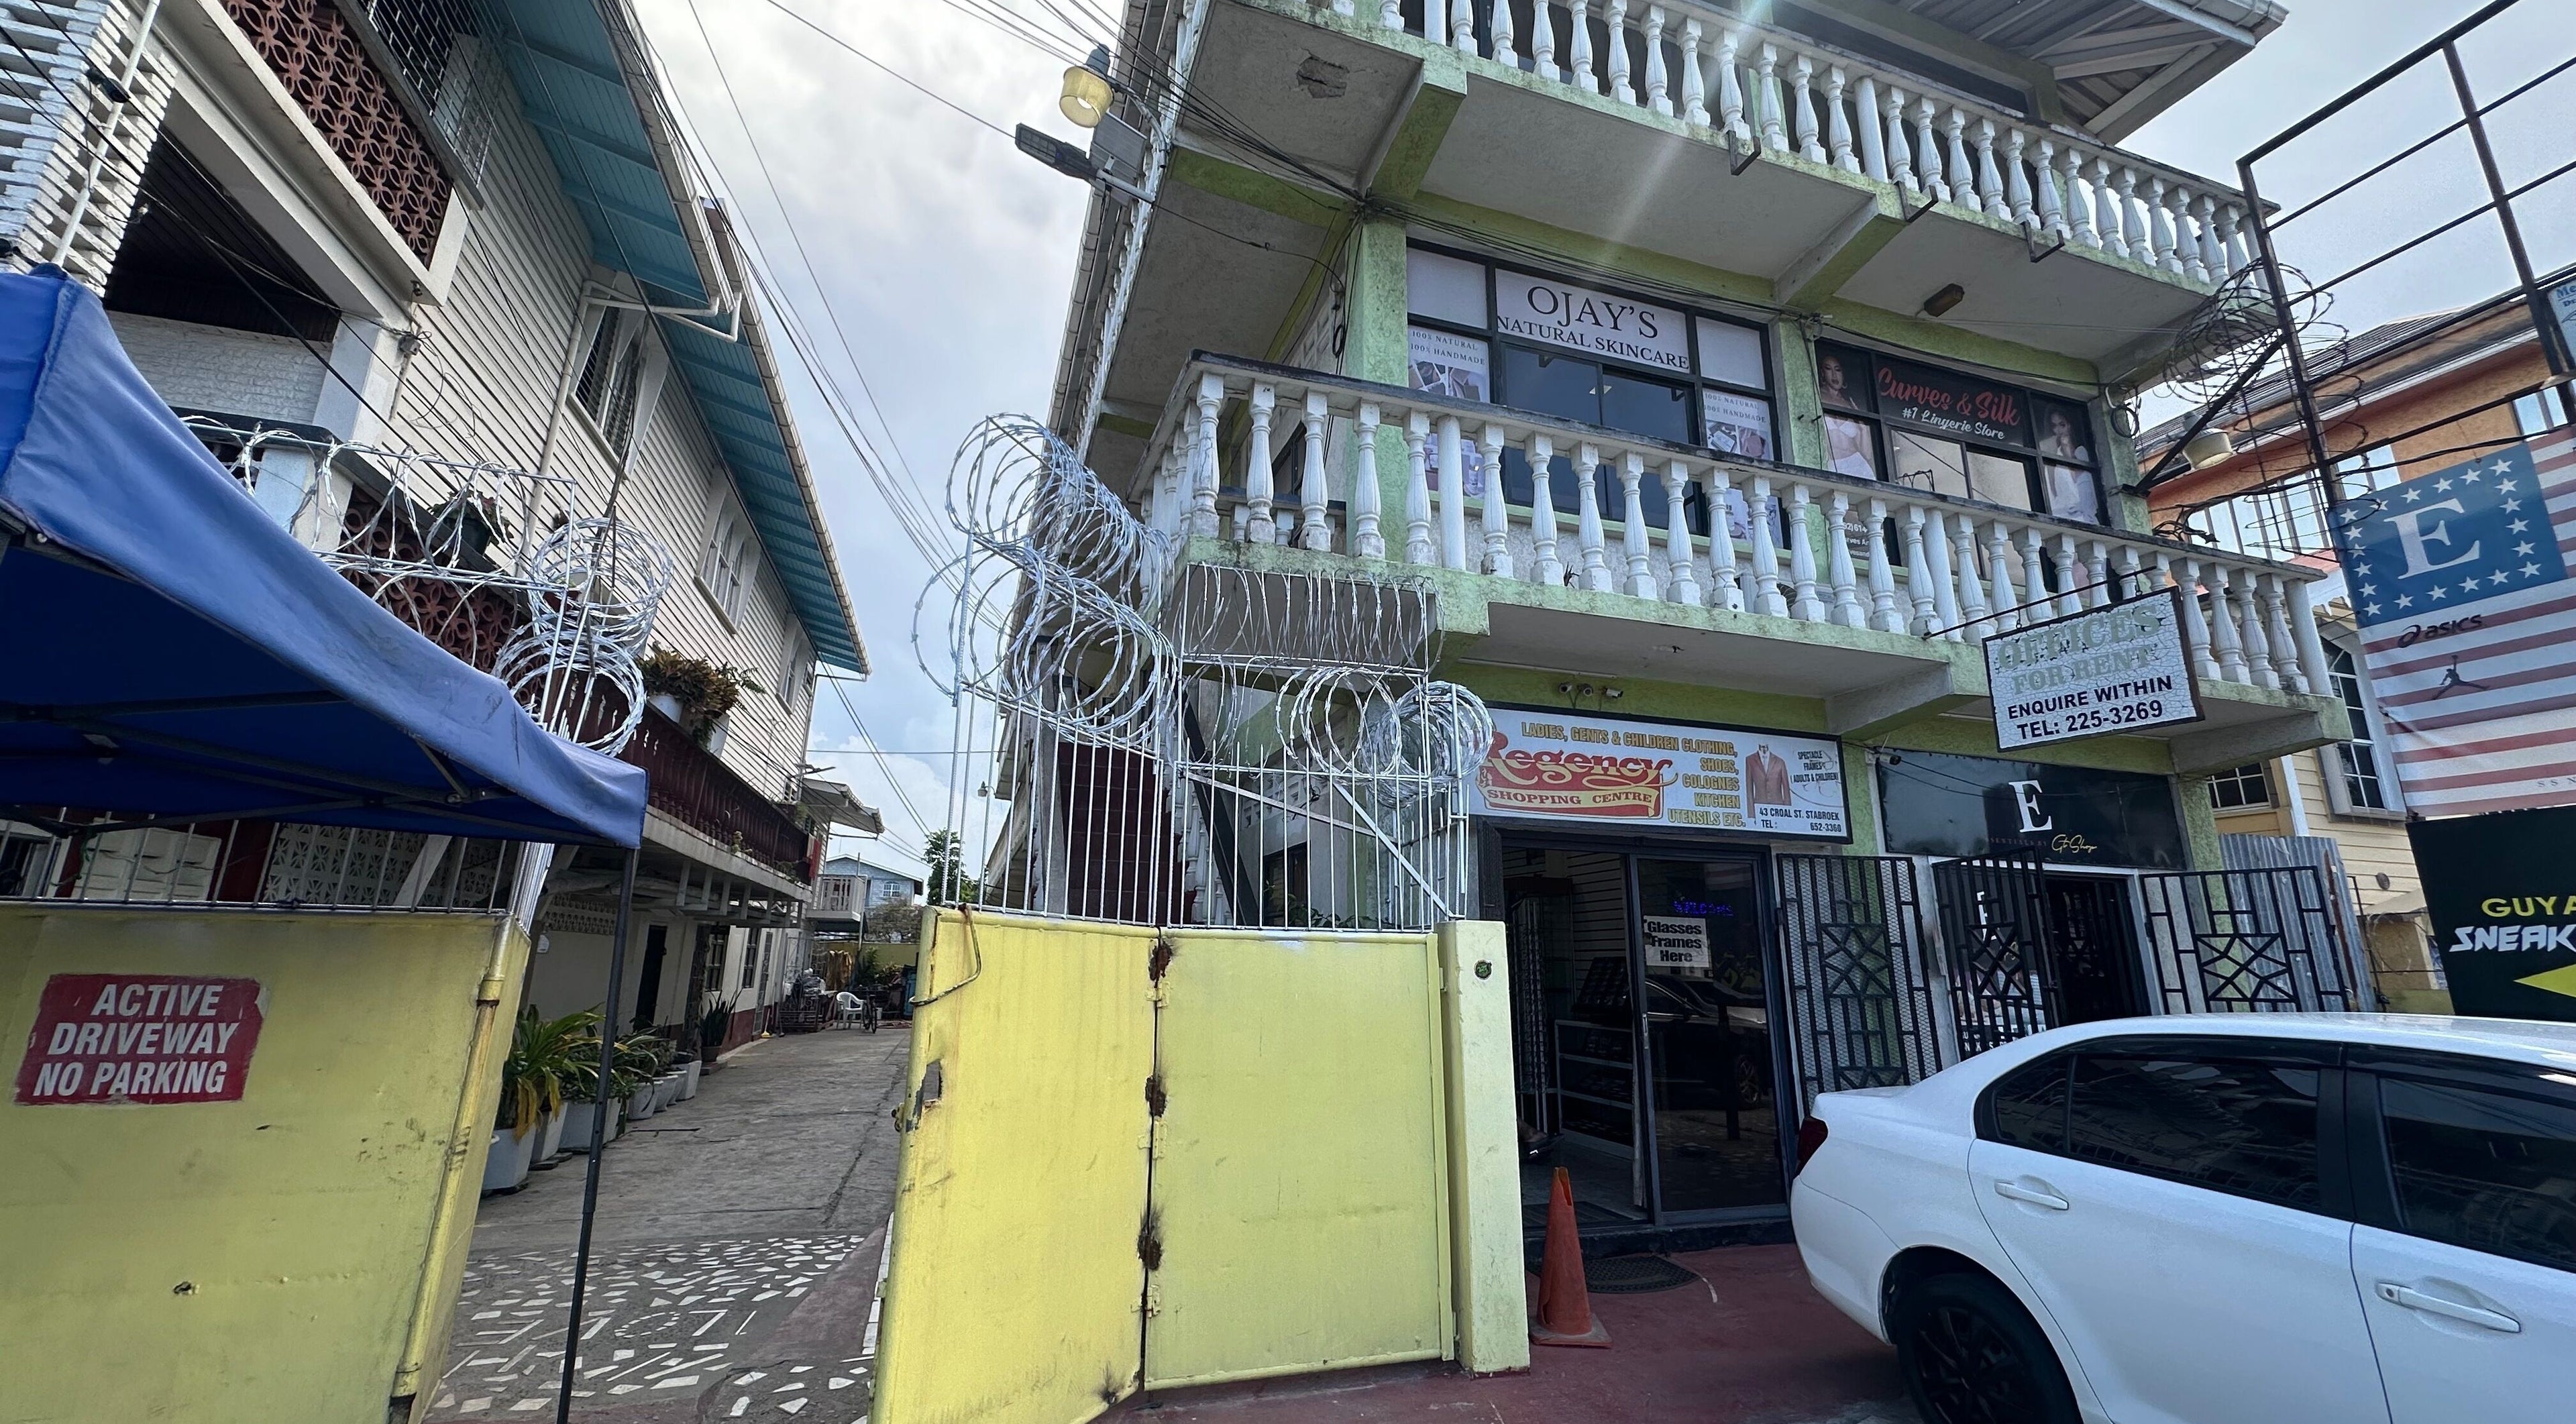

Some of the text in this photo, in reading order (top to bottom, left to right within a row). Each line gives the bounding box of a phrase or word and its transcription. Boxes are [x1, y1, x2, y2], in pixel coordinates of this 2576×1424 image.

[1527, 286, 1658, 339] OJAY'S
[1412, 331, 1478, 351] 100% NATURAL
[1497, 316, 1689, 370] NATURAL SKINCARE
[1411, 343, 1486, 365] 100% HANDMADE
[1724, 397, 1758, 410] NATURAL
[1878, 368, 2021, 425] Curves & Silk
[1723, 408, 1766, 423] HANDMADE
[1902, 406, 2005, 439] #1 Lingerie Store
[2383, 498, 2481, 580] E
[1998, 604, 2161, 669] OFFICES
[2014, 645, 2152, 695] FOR RENT
[2007, 675, 2173, 720] ENQUIRE WITHIN
[2017, 699, 2163, 740] TEL: 225-3269
[1521, 721, 1738, 757] LADIES, GENTS & CHILDREN CLOTHING,
[1481, 730, 1678, 791] Regency
[1699, 757, 1739, 775] SHOES,
[1798, 751, 1823, 760] SPECTACLE
[1803, 761, 1823, 771] FRAMES
[1682, 773, 1740, 791] COLOGNES
[1487, 788, 1652, 805] SHOPPING CENTRE
[1694, 792, 1740, 809] KITCHEN
[2008, 779, 2053, 833] E
[1666, 808, 1746, 828] UTENSILS ETC.
[1759, 808, 1768, 816] 43
[1770, 808, 1792, 818] CROAL
[1805, 810, 1840, 821] STABROEK
[1810, 822, 1841, 832] 652-3360
[1647, 921, 1702, 935] Glasses
[2449, 924, 2576, 952] SNEAK
[1652, 935, 1702, 948] Frames
[1660, 950, 1693, 963] Here
[91, 983, 224, 1016] ACTIVE
[48, 1022, 240, 1055] DRIVEWAY
[32, 1060, 227, 1096] NO PARKING
